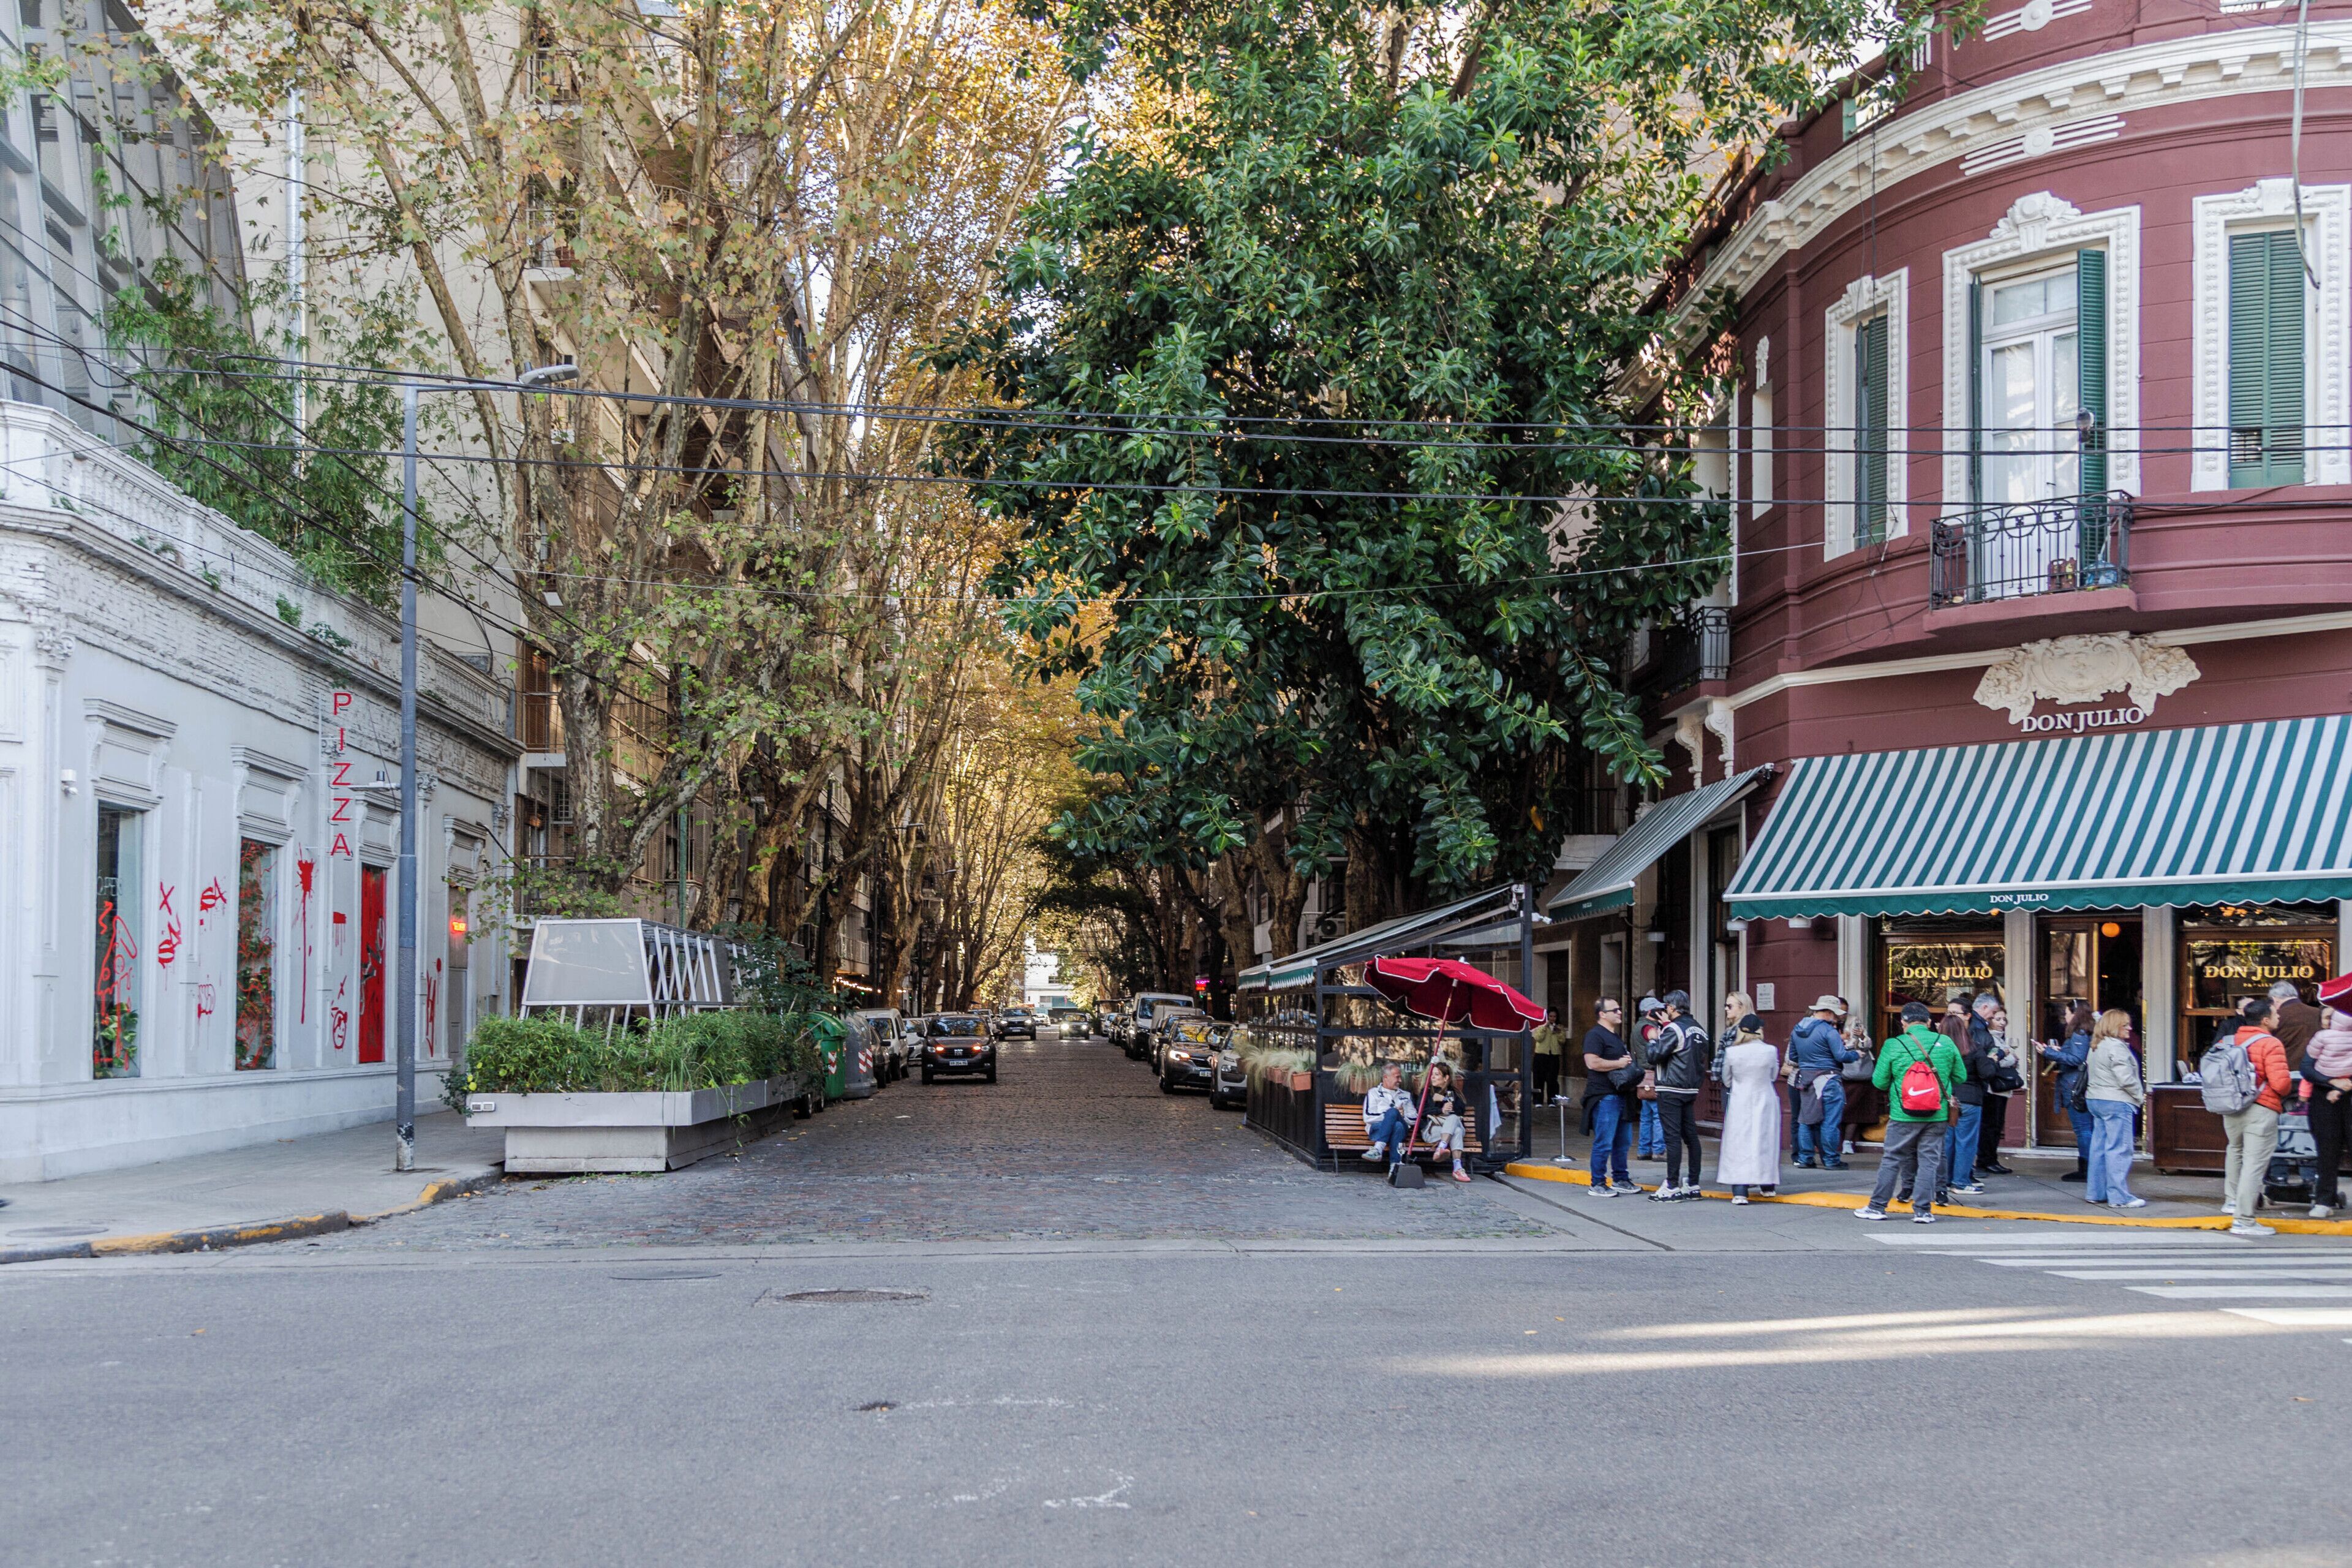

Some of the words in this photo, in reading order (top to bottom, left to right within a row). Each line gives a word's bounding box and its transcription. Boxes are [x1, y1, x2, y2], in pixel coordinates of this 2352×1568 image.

[2021, 713, 2073, 732] DON
[2073, 707, 2145, 733] JULIO
[330, 693, 353, 856] PIZZA
[1989, 894, 2013, 903] DON
[2013, 894, 2049, 905] JULIO
[1902, 967, 1939, 978] DON
[1941, 966, 1993, 981] JULIO
[2204, 965, 2248, 978] DON
[2251, 965, 2315, 981] JULIO
